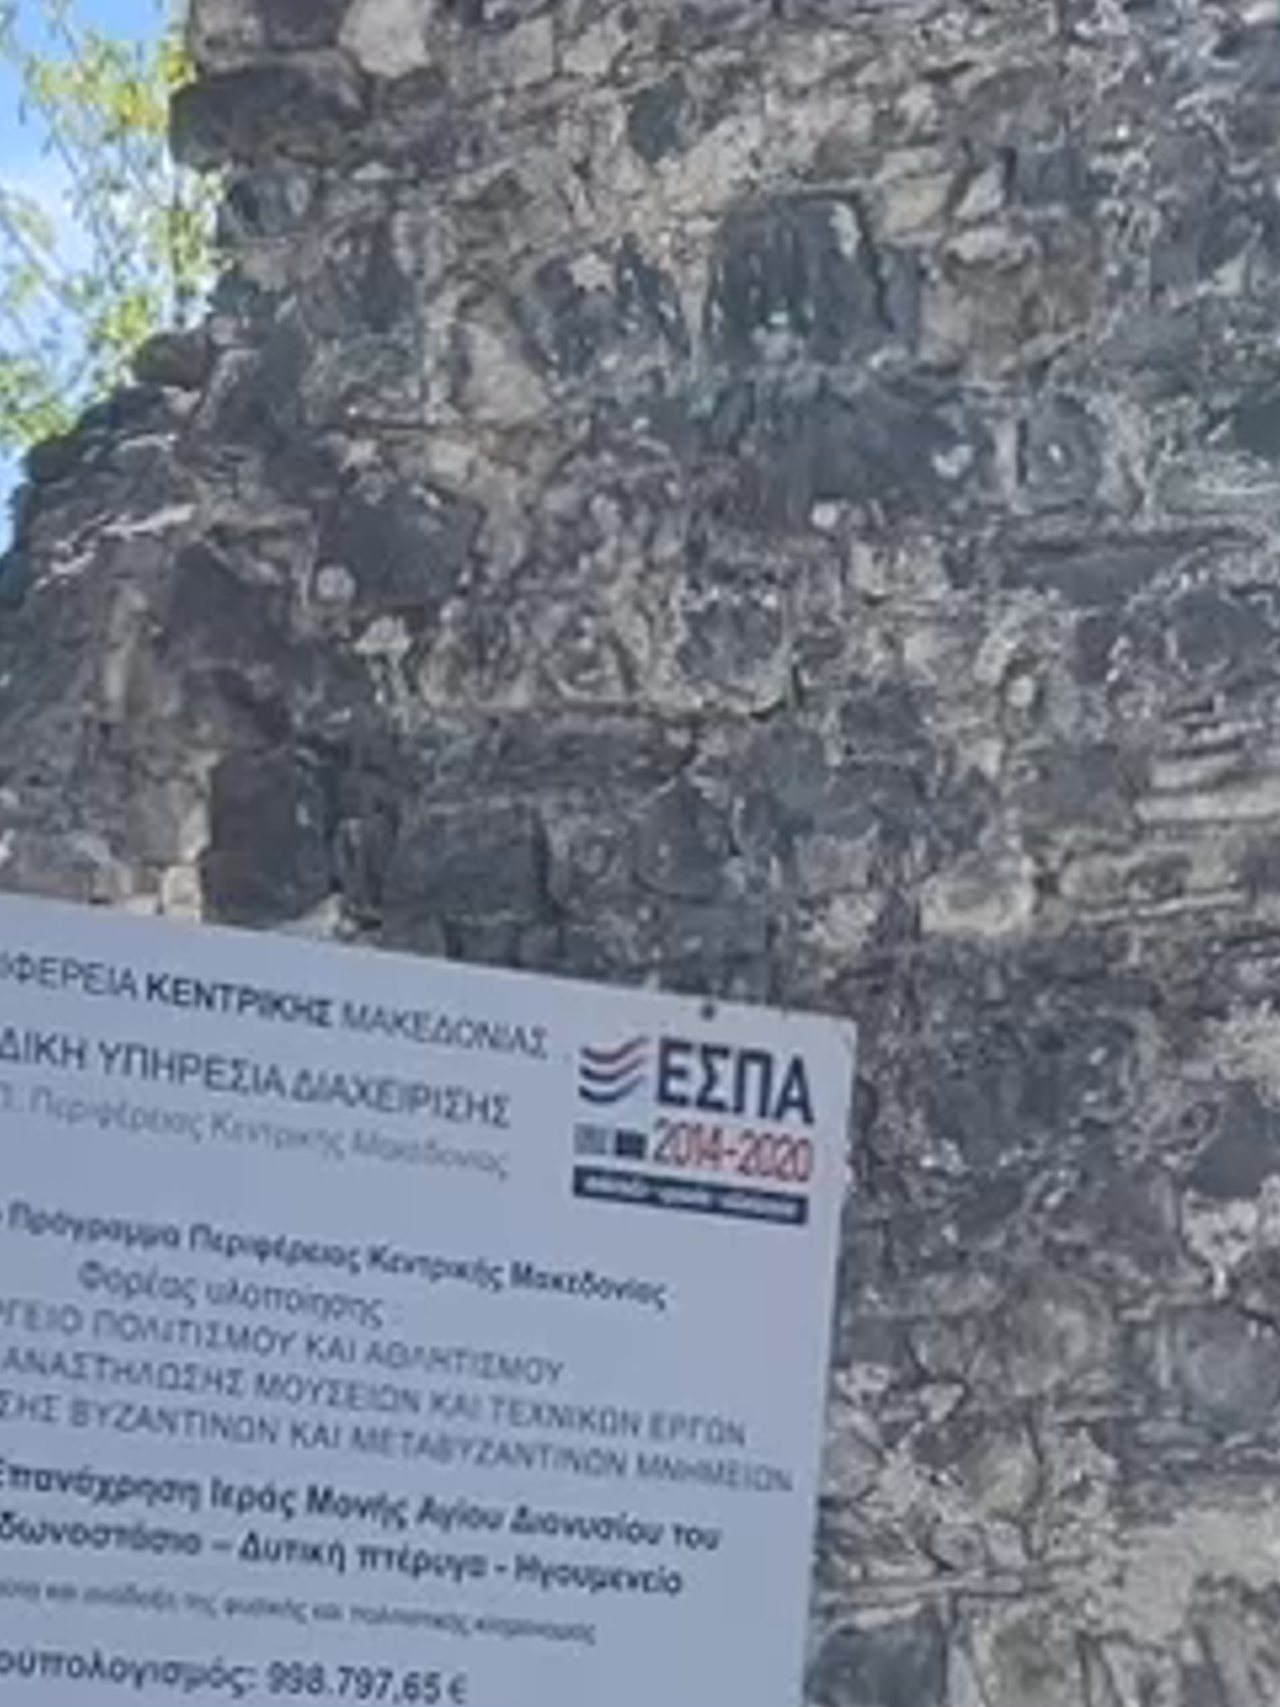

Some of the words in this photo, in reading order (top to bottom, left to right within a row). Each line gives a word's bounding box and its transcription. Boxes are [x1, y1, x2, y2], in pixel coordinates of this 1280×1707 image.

[145, 971, 332, 1029] ΚΕΝΤΡΙΚΗΣ
[342, 1002, 548, 1060] ΜΑΚΕΔΟΝΙΑΣ
[97, 1041, 285, 1099] ΥΠΗΡΕΣΙΑ
[292, 1069, 511, 1128] ΔΙΑΧΕΙΡΙΣΗΣ
[656, 1036, 815, 1126] ΕΣΠΑ
[652, 1117, 811, 1182] 2014-2020
[8, 1202, 180, 1250] Πρόγραμμα
[189, 1224, 362, 1274] Περιφέρειας
[368, 1245, 504, 1291] Κεντρικής
[510, 1261, 668, 1310] Μακεδονίας
[78, 1260, 197, 1307] Φορέας
[93, 1310, 295, 1355] ΠΟΛΙΤΙΣΜΟΥ
[306, 1335, 356, 1363] ΚΑΙ
[365, 1341, 564, 1386] ΑΘΛΗΤΙΣΜΟΥ
[0, 1346, 244, 1397] ΑΝΑΣΤΗΛΩΣΗΣ
[255, 1371, 420, 1415] ΜΟΥΣΕΙΩΝ
[430, 1391, 481, 1422] ΚΑΙ
[490, 1395, 641, 1438] ΤΕΧΝΙΚΩΝ
[649, 1411, 746, 1447] ΕΡΓΩΝ
[70, 1398, 279, 1445] ΒΥΖΑΝΤΙΝΩΝ
[290, 1418, 341, 1450] ΚΑΙ
[350, 1426, 627, 1478] ΜΕΤΑΒΥΖΑΝΤΙΝΩΝ
[635, 1452, 793, 1493] ΜΝΗΜΕΙΩΝ
[211, 1479, 296, 1520] Ιεράς
[306, 1485, 408, 1530] Μονής
[417, 1494, 505, 1534] Αγίου
[511, 1505, 665, 1547] Διονυσίου
[674, 1524, 723, 1551] του
[238, 1531, 346, 1573] Δυτική
[357, 1541, 488, 1584] πτέρυγα
[515, 1552, 684, 1596] Ηγουμενείο
[267, 1660, 443, 1706] 998.797,65
[448, 1674, 469, 1706] €
